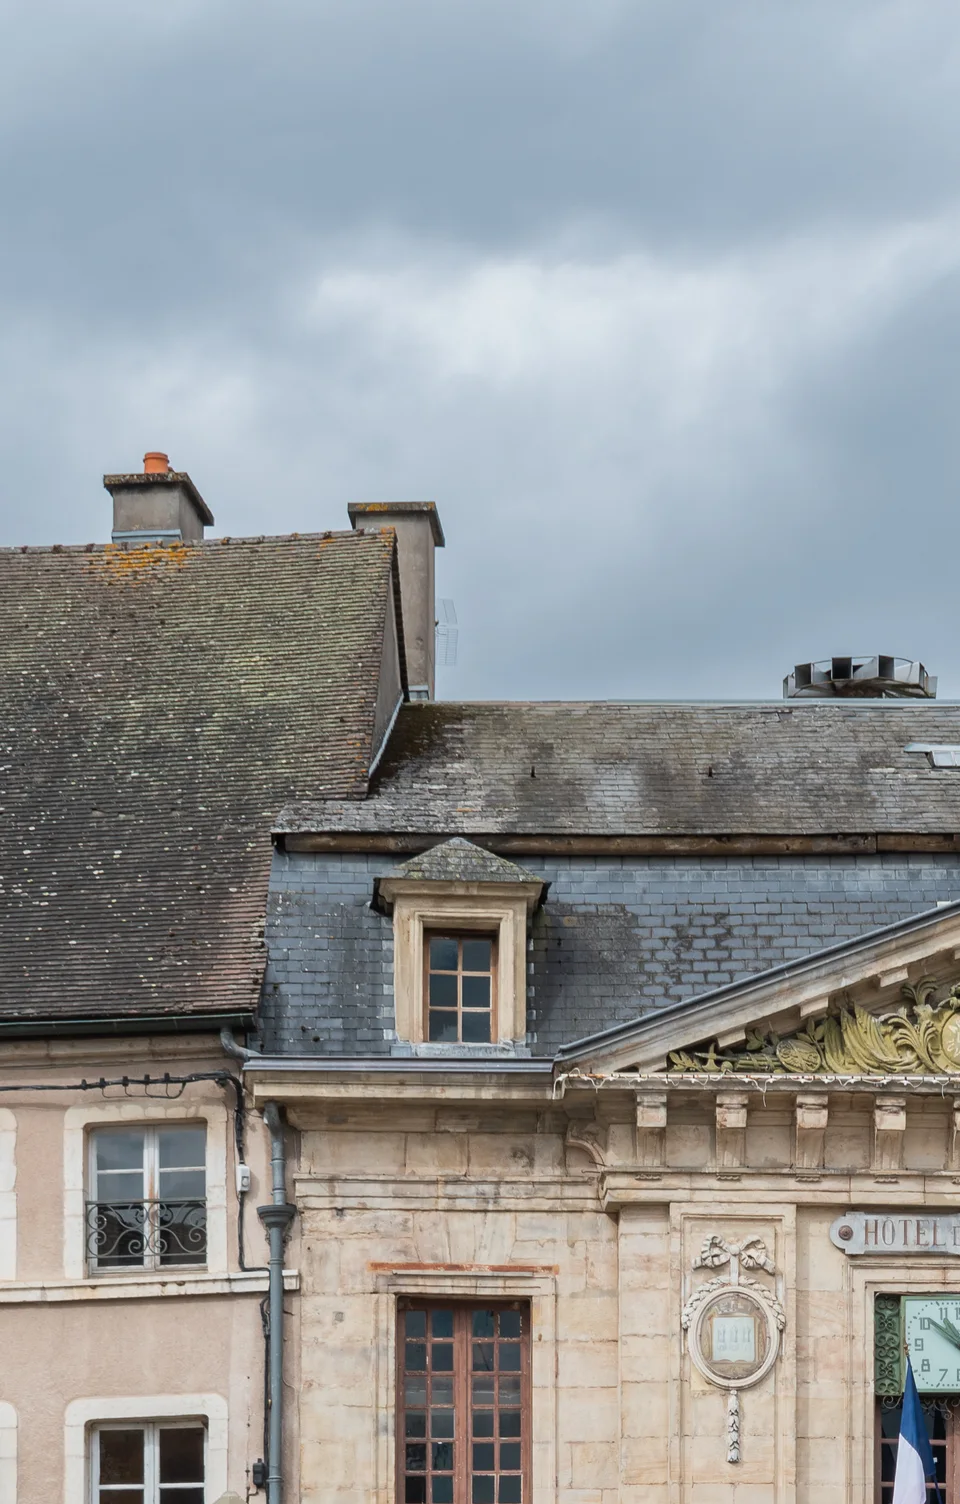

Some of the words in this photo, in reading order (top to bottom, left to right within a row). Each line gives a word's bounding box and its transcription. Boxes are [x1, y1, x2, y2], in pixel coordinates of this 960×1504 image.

[864, 1216, 946, 1246] HÔTEL
[938, 1307, 948, 1320] 11
[919, 1317, 931, 1330] 10
[914, 1338, 924, 1351] 9
[921, 1358, 931, 1372] 8
[939, 1368, 949, 1382] 7
